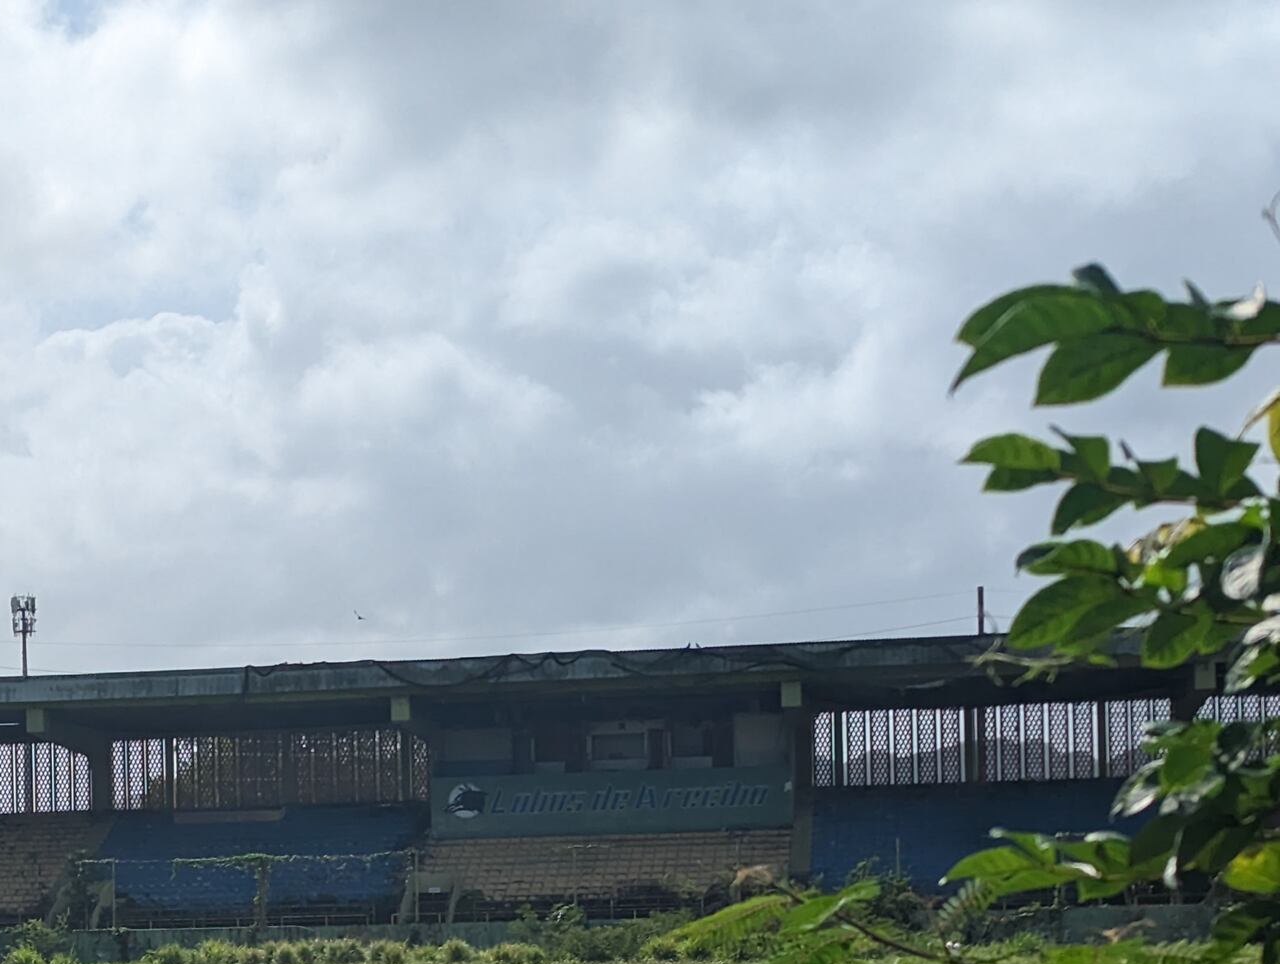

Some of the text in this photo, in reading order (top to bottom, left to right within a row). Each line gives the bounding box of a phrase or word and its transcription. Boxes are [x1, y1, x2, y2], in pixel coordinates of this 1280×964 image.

[491, 780, 769, 814] Lobos de Arecibo
